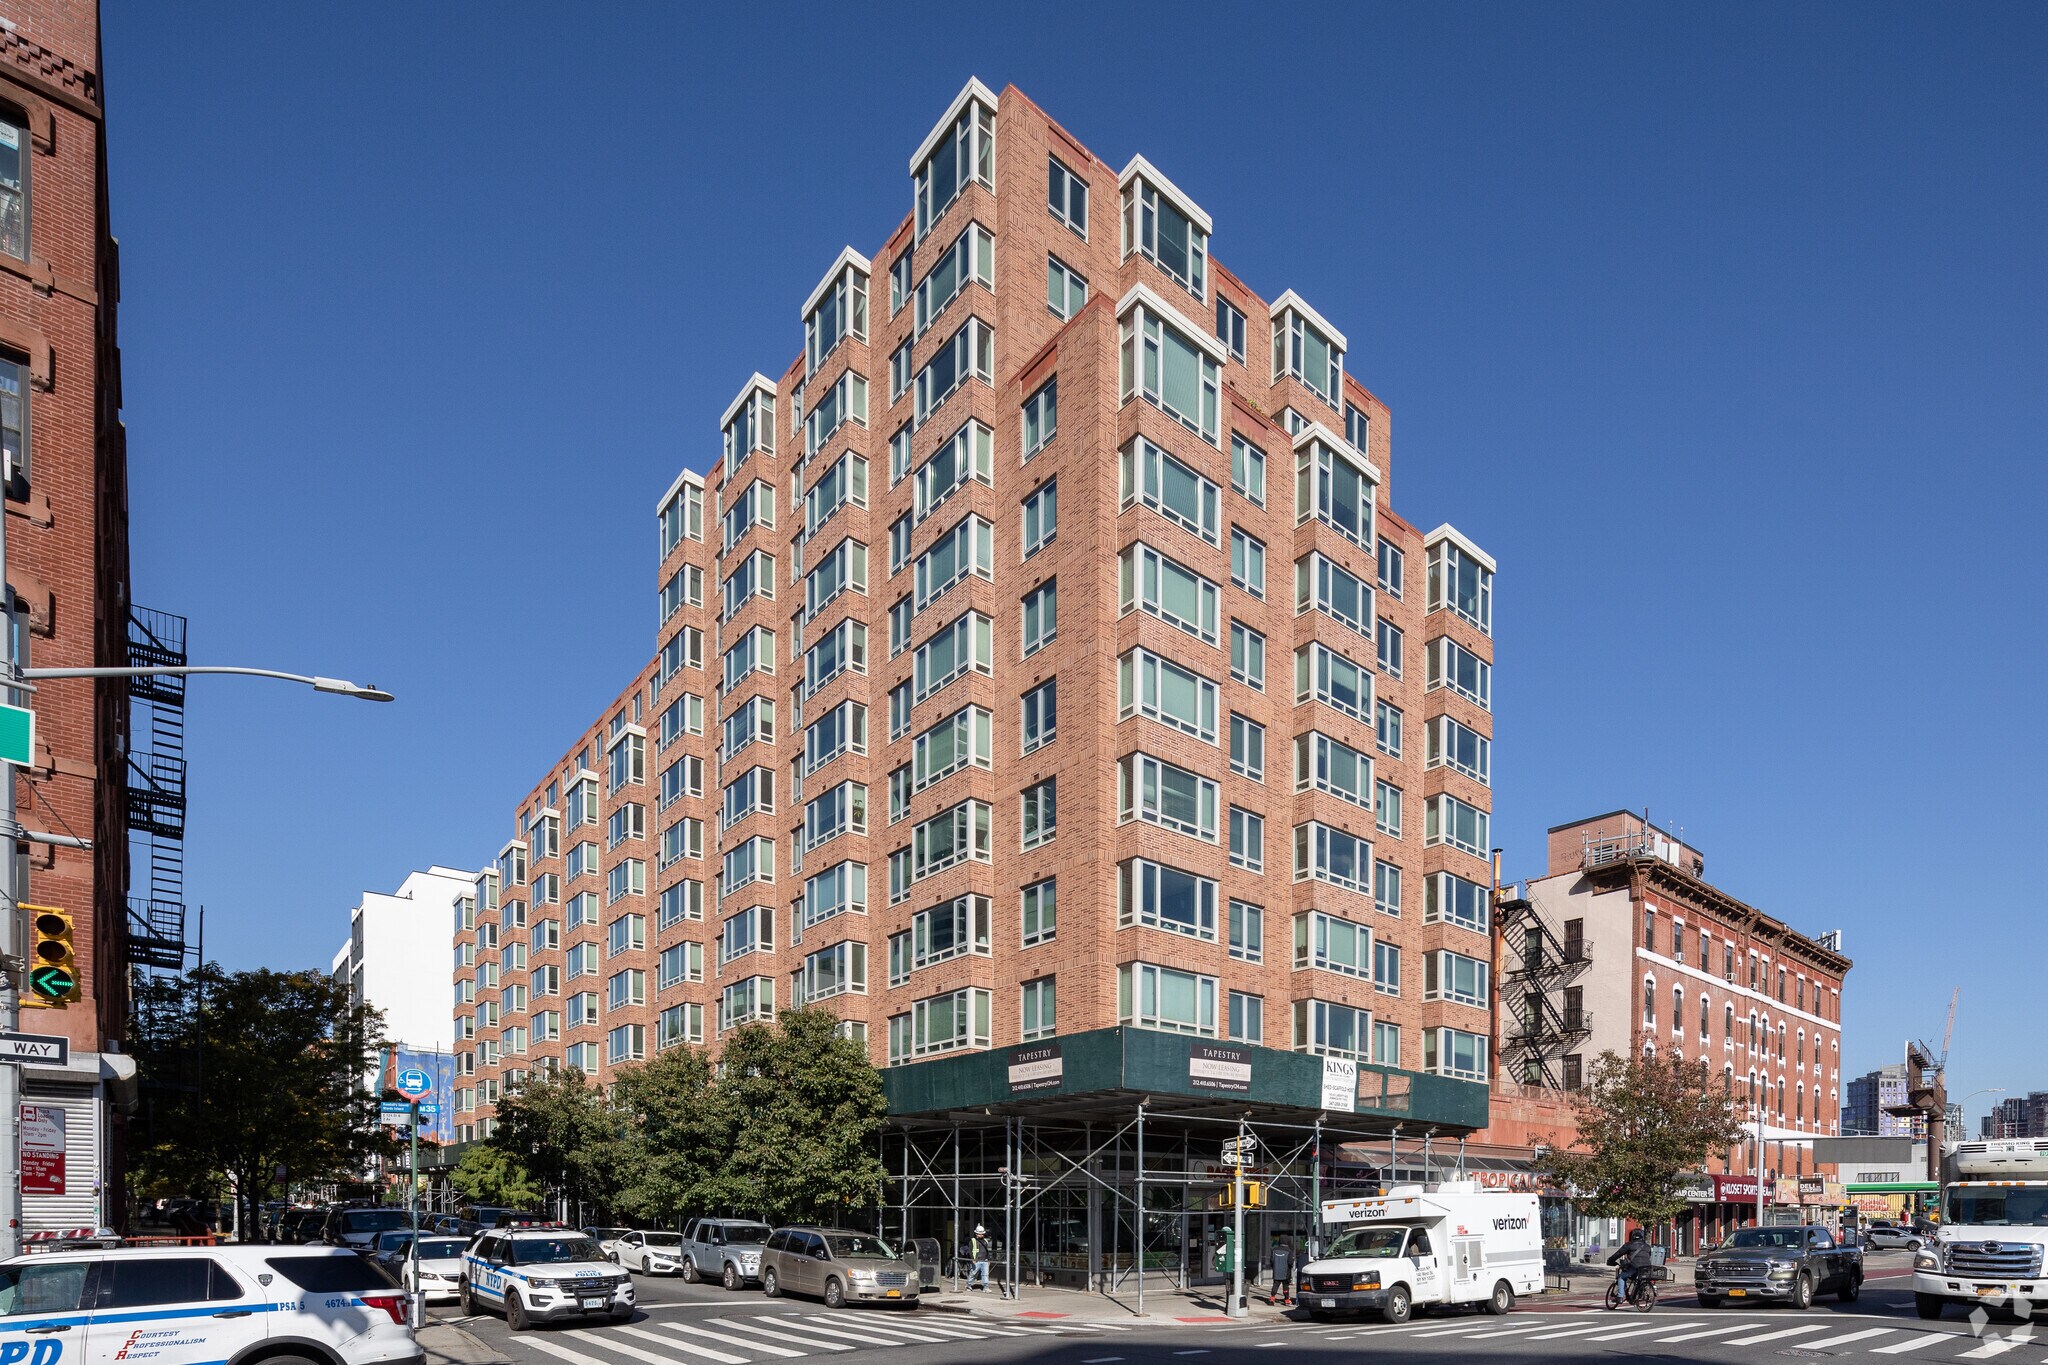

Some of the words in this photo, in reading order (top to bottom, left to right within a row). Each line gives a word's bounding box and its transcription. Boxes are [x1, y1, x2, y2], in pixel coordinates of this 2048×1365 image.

[14, 1042, 51, 1056] WAY
[1203, 1048, 1241, 1060] TAPESTRY
[1018, 1049, 1052, 1062] TAPESTRY
[1018, 1065, 1031, 1074] NOW
[1031, 1063, 1052, 1072] LEASING
[1202, 1062, 1217, 1070] NOW
[1218, 1064, 1240, 1073] LEASING
[1326, 1060, 1354, 1075] KINGS
[1225, 1141, 1236, 1149] ONE
[42, 1160, 56, 1168] Friday
[1472, 1171, 1533, 1189] TROPICAL
[1688, 1190, 1708, 1198] CENTER
[1725, 1183, 1743, 1195] KLOSET
[1349, 1208, 1385, 1219] verizon
[1492, 1214, 1528, 1231] verizon
[486, 1271, 501, 1289] NYPD
[280, 1301, 297, 1311] PSA
[300, 1301, 305, 1310] 5
[325, 1299, 345, 1308] 4674
[131, 1329, 180, 1340] COURTESY
[124, 1337, 207, 1350] PROFESSIONALISM
[114, 1350, 160, 1360] RESPECT
